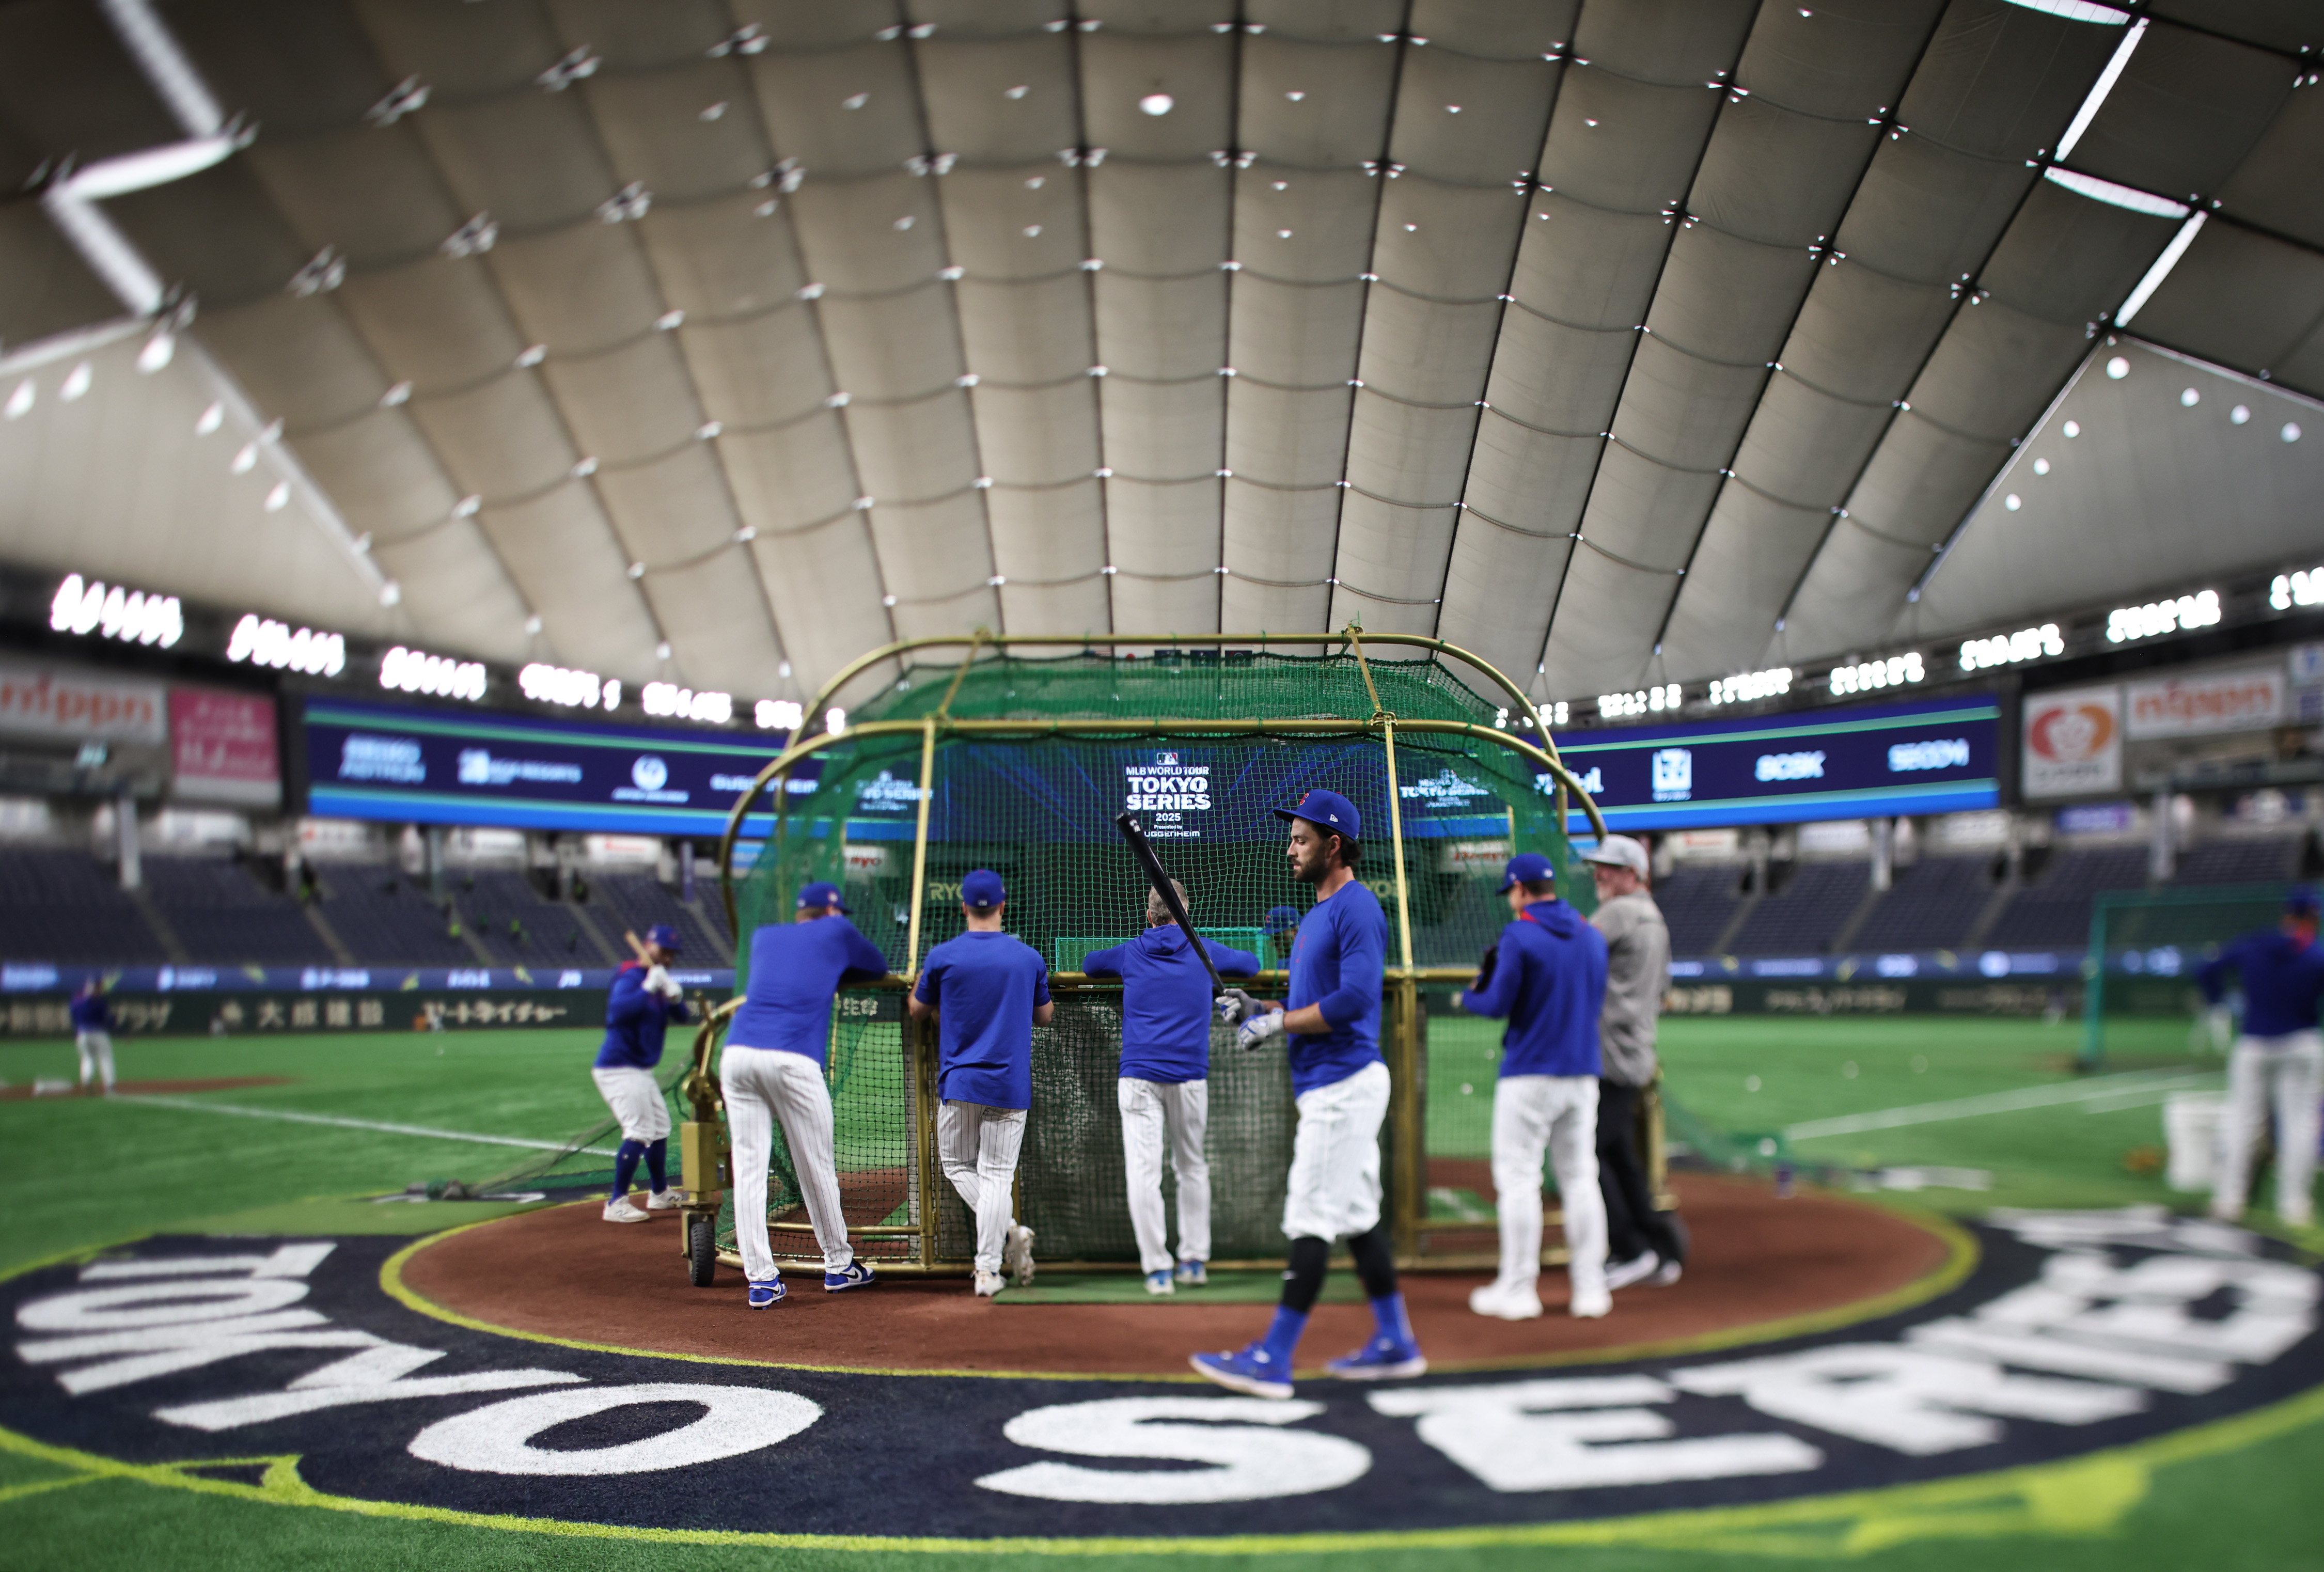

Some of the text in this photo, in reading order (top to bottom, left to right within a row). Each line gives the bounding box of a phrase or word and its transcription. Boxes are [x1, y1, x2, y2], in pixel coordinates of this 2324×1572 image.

[1126, 766, 1210, 775] MLB WORLD TOUR
[1127, 777, 1208, 793] TOKYO
[1126, 794, 1211, 810] SERIES
[1155, 813, 1181, 822] 2025
[15, 1241, 824, 1476] TOKYO
